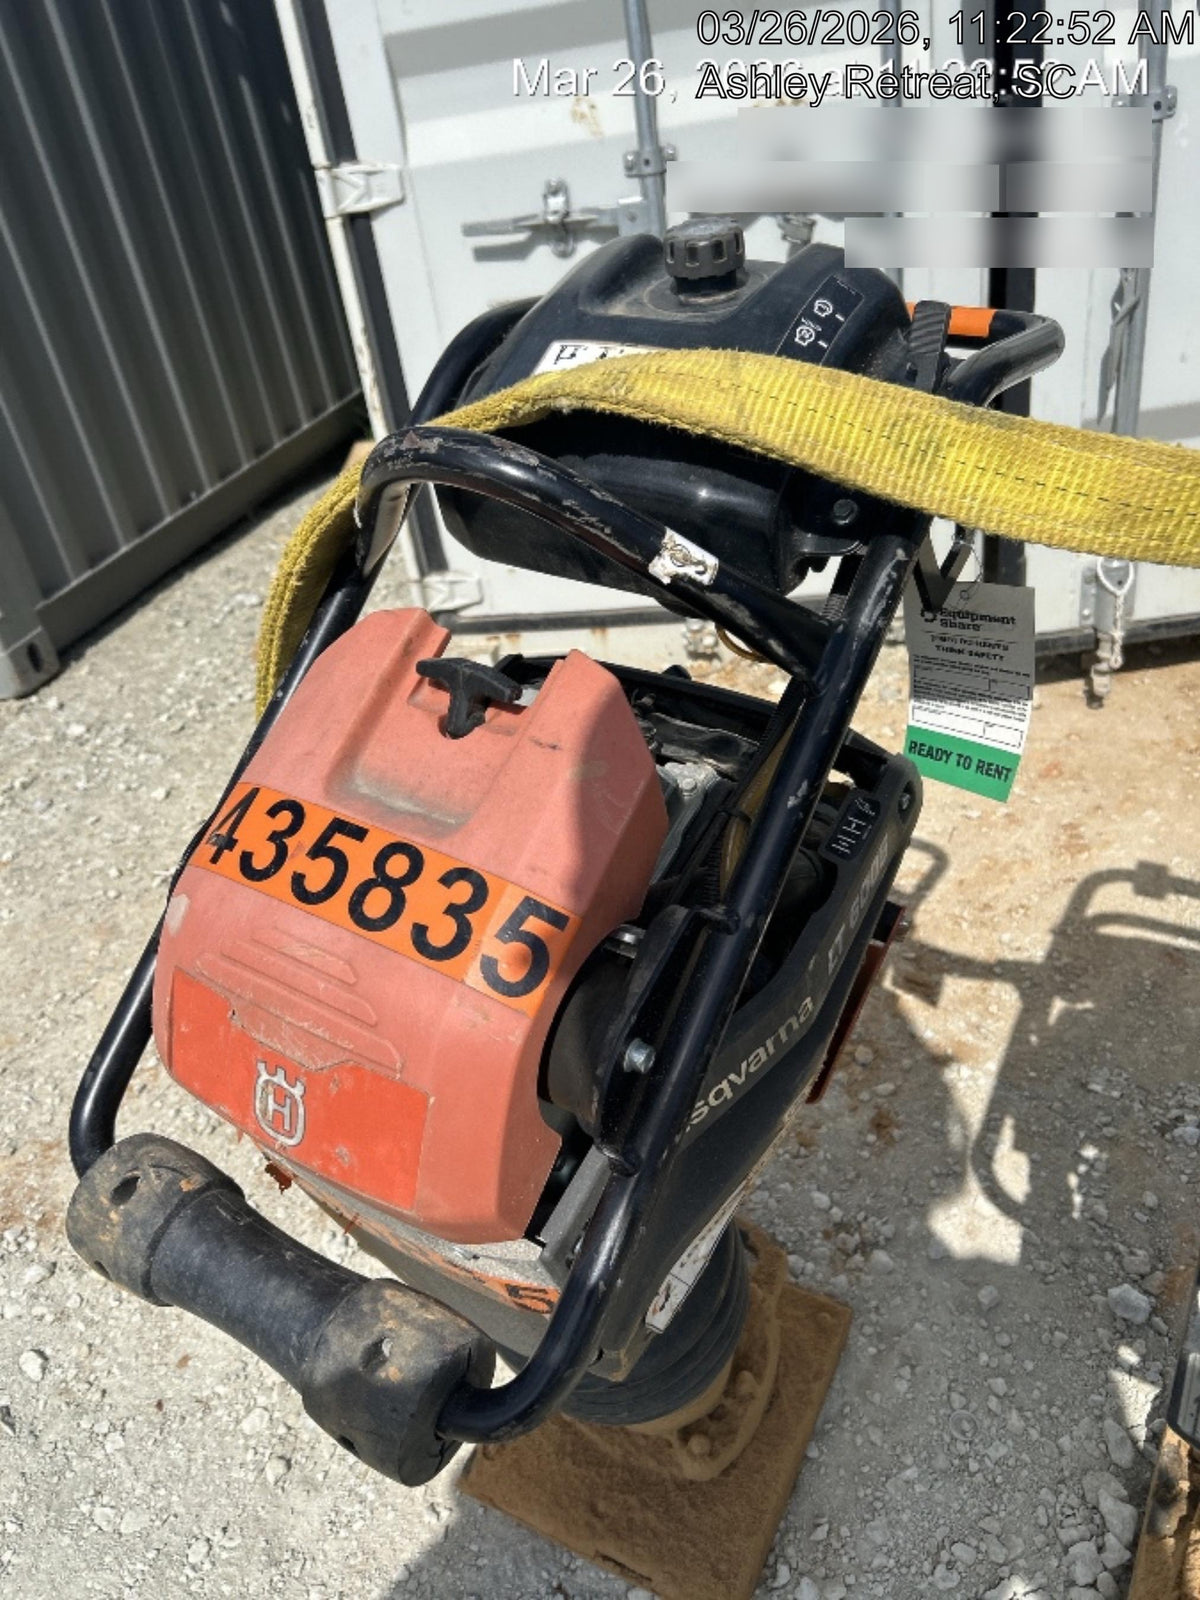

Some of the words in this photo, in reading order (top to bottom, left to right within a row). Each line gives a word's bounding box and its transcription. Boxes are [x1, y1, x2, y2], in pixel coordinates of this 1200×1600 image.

[908, 740, 953, 766] READY
[955, 752, 973, 771] TO
[975, 758, 1012, 783] RENT
[206, 786, 571, 999] 435835
[672, 996, 813, 1146] sqvarna
